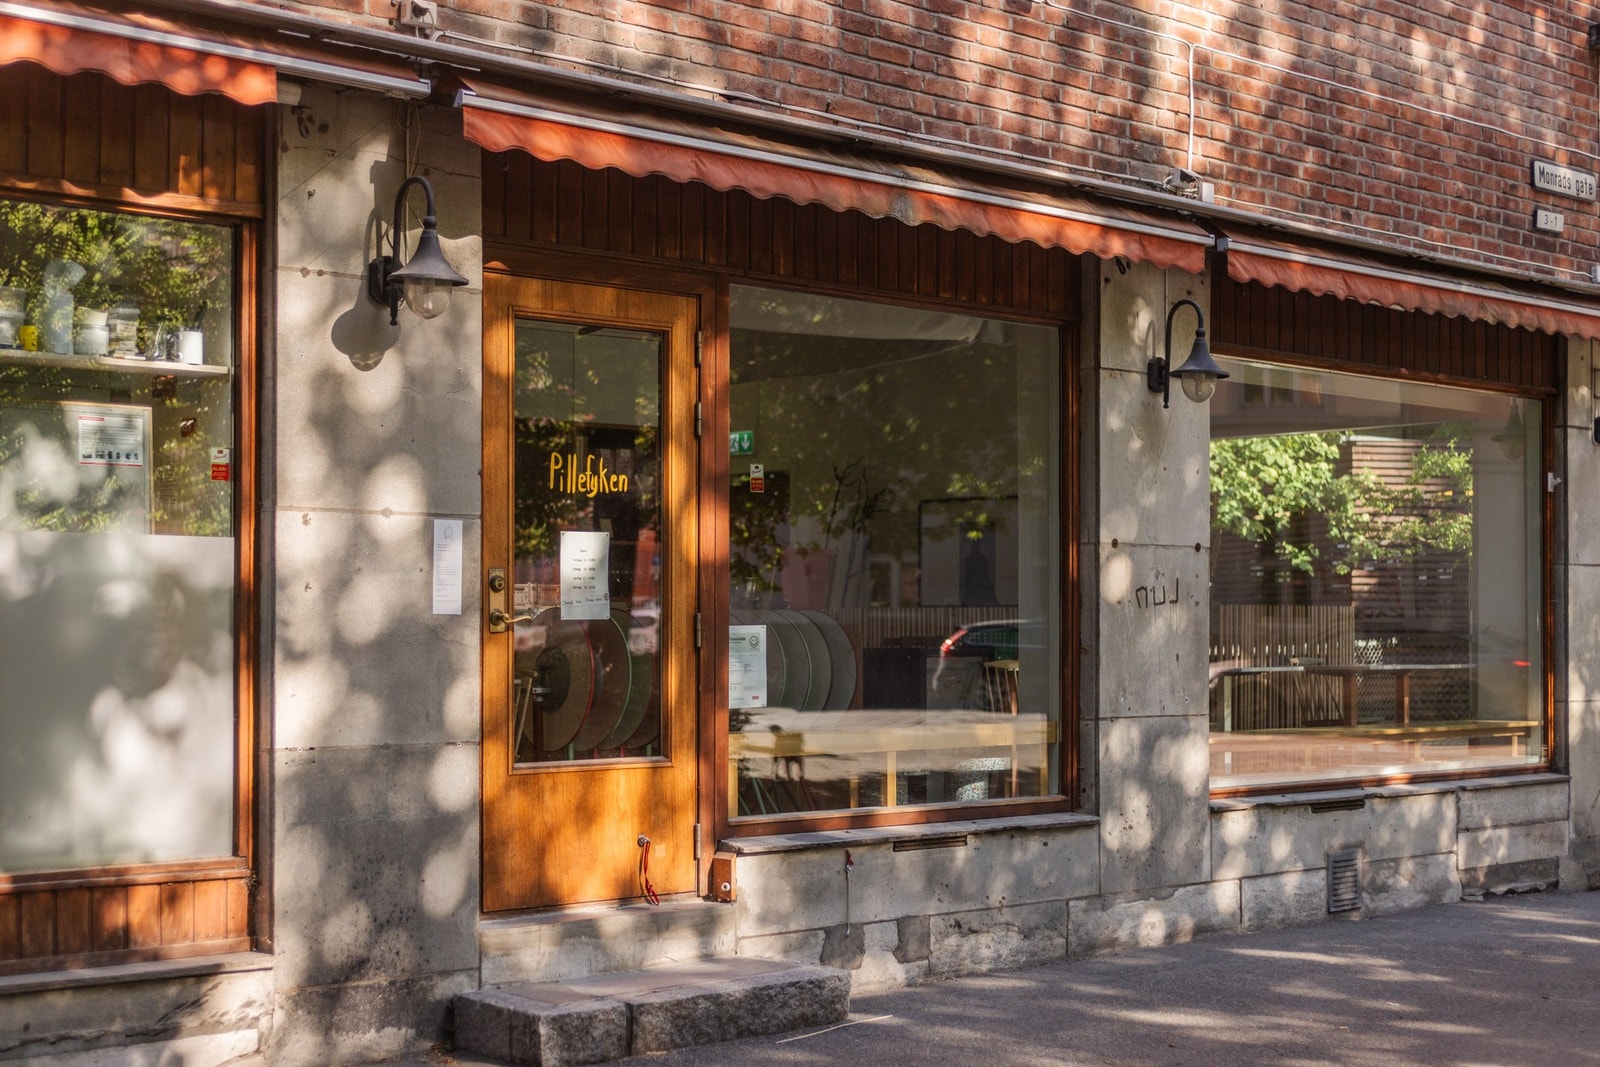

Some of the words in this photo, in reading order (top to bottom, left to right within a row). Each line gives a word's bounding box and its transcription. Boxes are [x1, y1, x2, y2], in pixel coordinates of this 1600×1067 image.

[1538, 165, 1572, 190] Monrads
[1575, 178, 1593, 196] gate
[549, 451, 628, 498] Pillefyken
